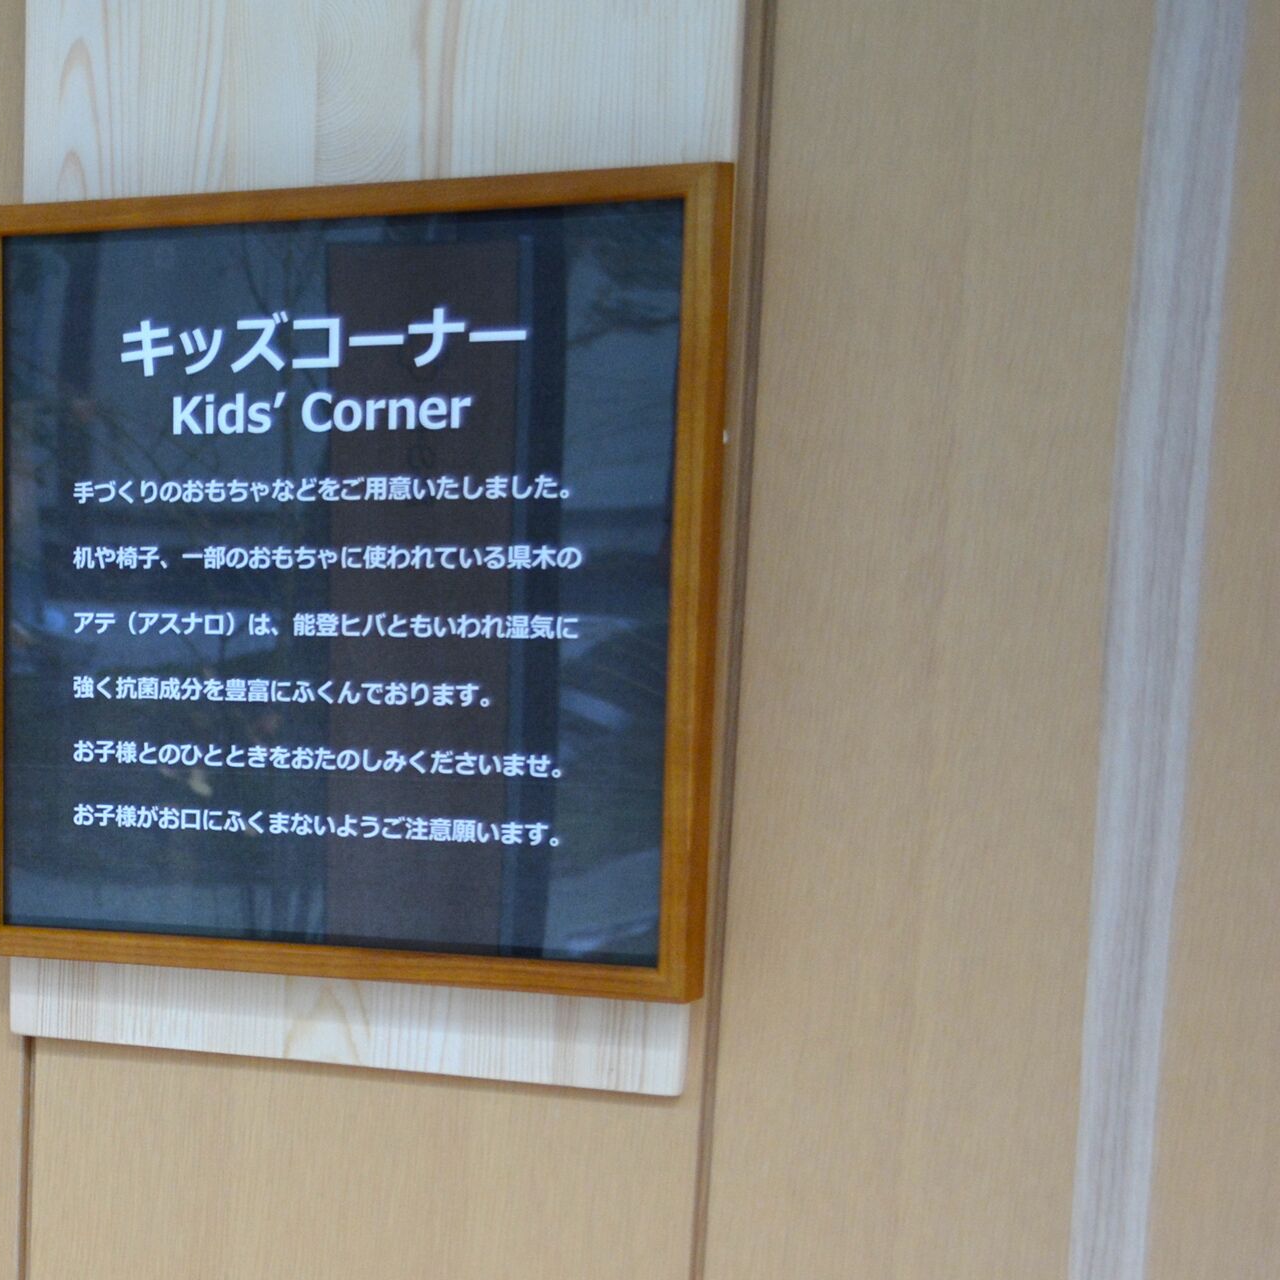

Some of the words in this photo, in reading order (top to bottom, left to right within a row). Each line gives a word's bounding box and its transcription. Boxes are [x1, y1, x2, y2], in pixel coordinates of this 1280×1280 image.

[121, 308, 527, 377] キッズコーナー
[301, 391, 472, 433] Corner
[73, 474, 570, 504] 手づくりのおもちゃなどをご用意いたしました。
[72, 544, 583, 571] 机や椅子、一部のおもちゃに使われている県木の
[73, 610, 579, 640] アテ（アスナロ）は、能登ヒバともいわれ湿気に
[73, 675, 490, 708] 強く抗菌成分を豊富にふくんでおります。
[73, 739, 563, 779] お子様とのひとときをおたのしみくださいませ。
[73, 803, 561, 847] お子様がお口にふくまないようご注意願います。
